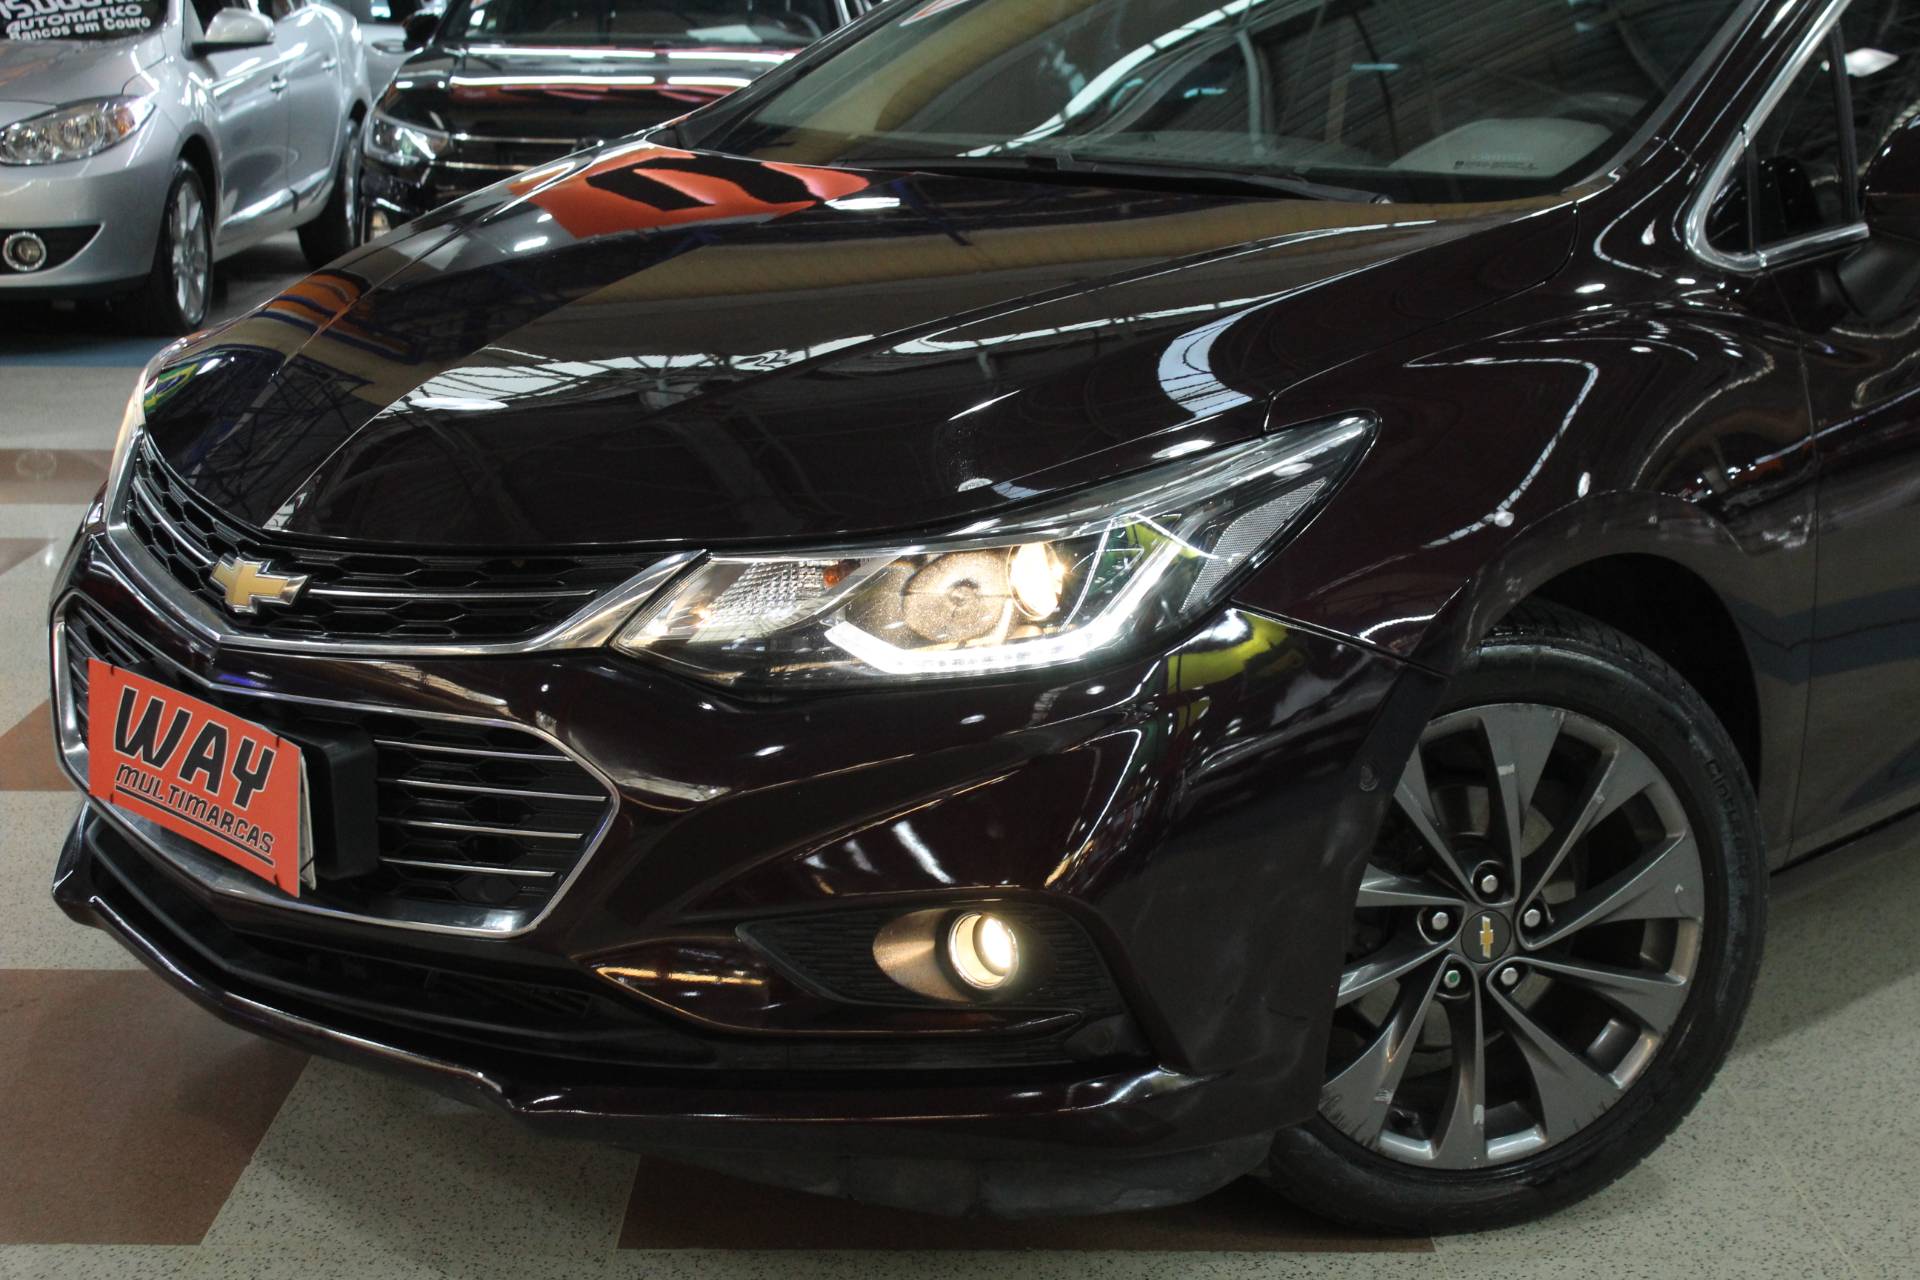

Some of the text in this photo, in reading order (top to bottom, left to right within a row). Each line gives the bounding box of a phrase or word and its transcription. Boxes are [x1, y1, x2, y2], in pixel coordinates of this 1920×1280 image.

[9, 16, 151, 41] Bancos em Couro
[114, 685, 276, 811] WAY
[115, 763, 275, 855] MULTIMARCAS
